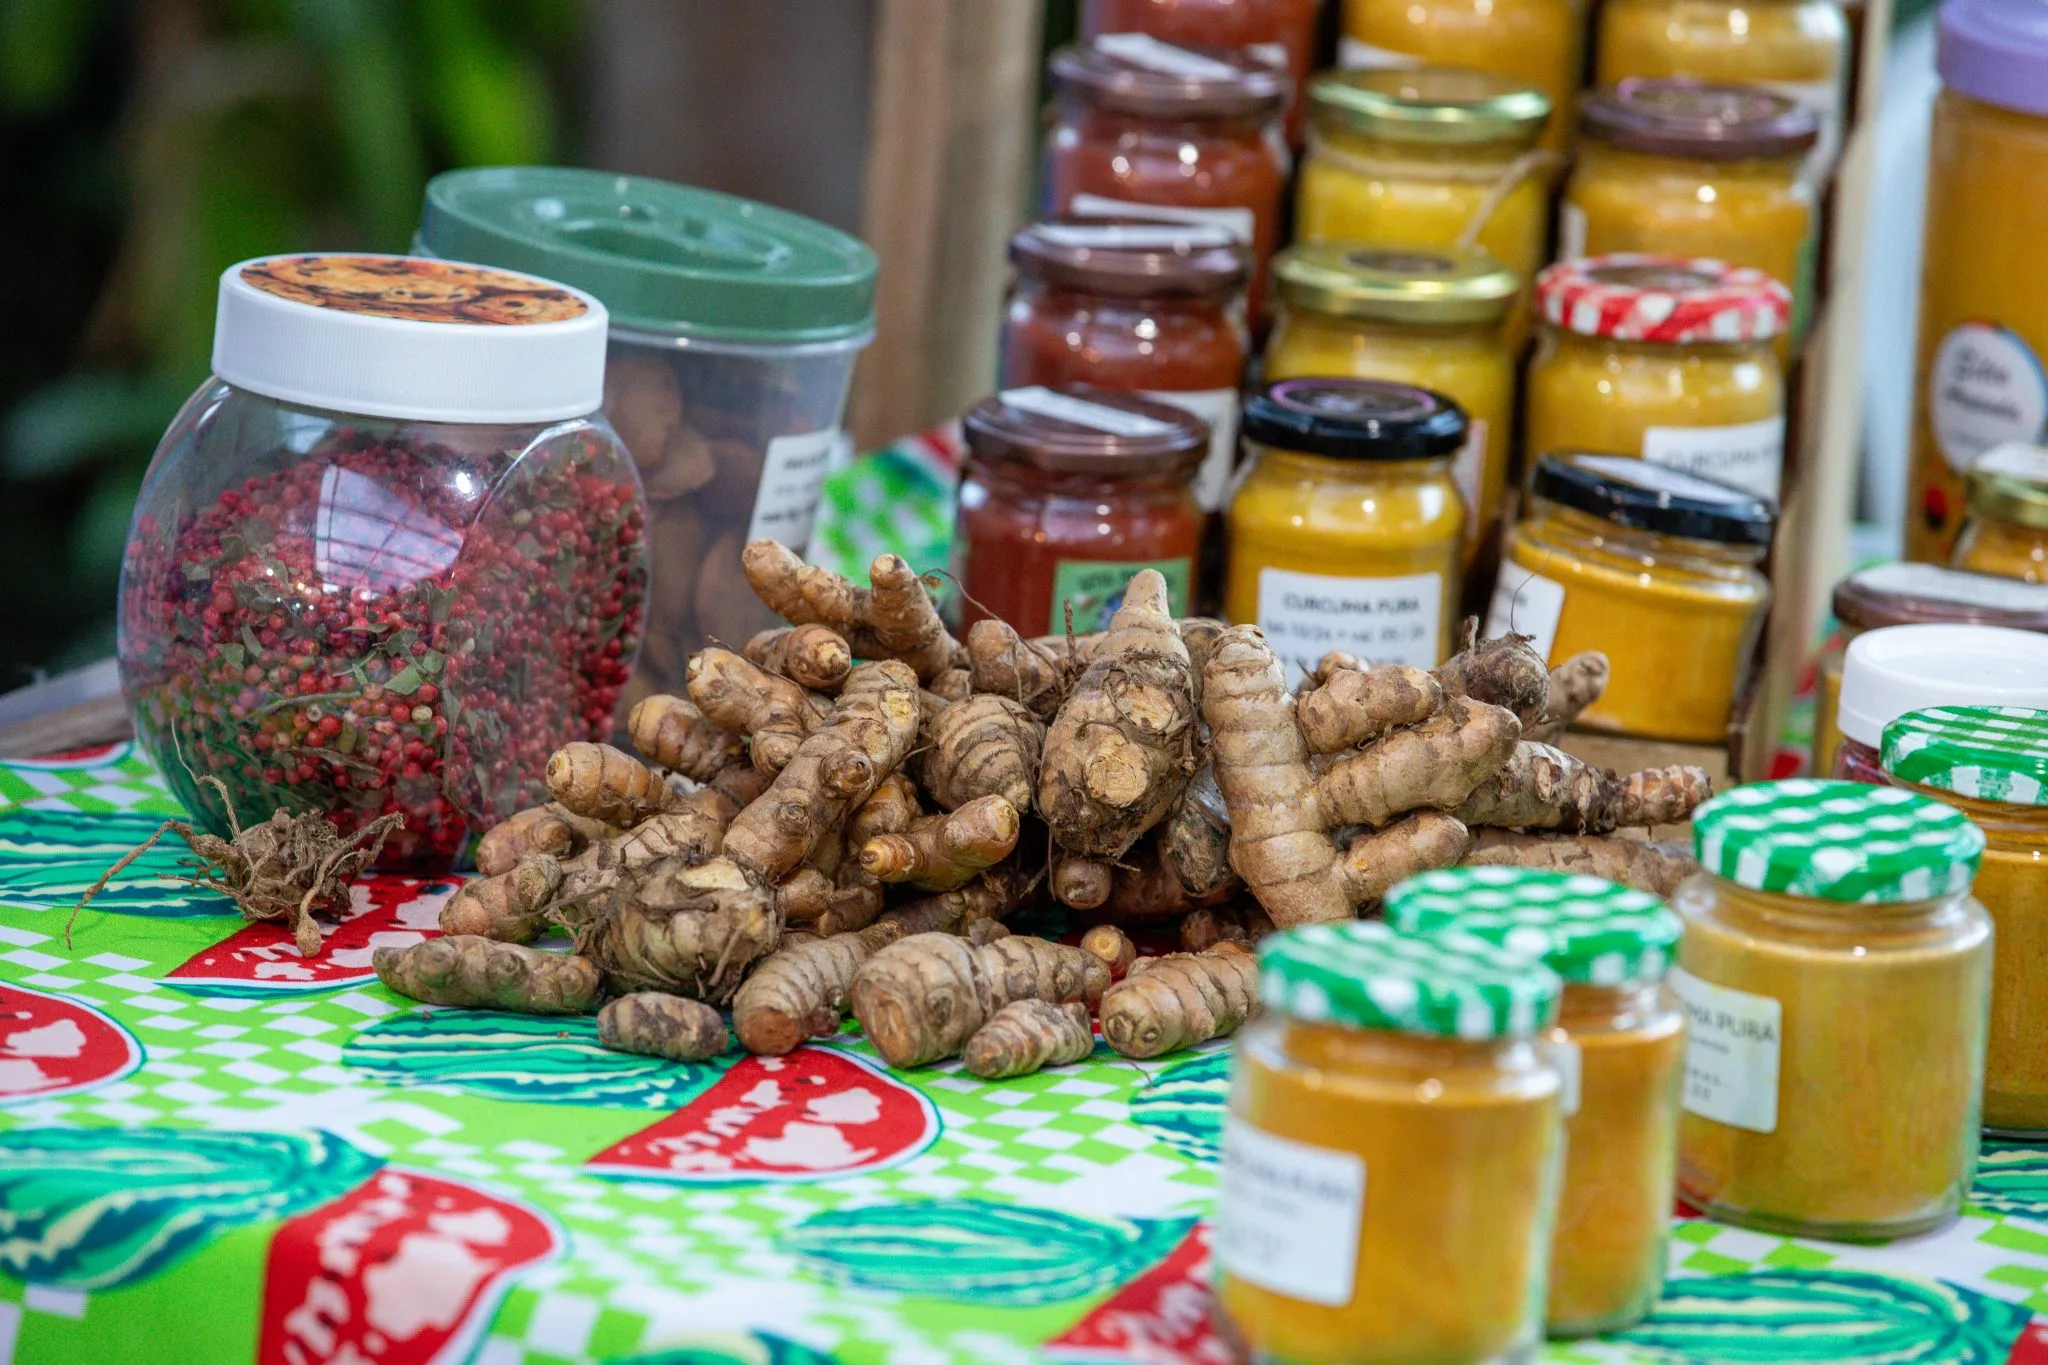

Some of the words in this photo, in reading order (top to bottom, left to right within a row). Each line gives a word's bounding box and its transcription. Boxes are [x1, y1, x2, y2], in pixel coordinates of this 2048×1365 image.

[1282, 591, 1372, 614] CURCUMA
[1378, 596, 1420, 614] PURA
[1716, 1011, 1774, 1041] PURA
